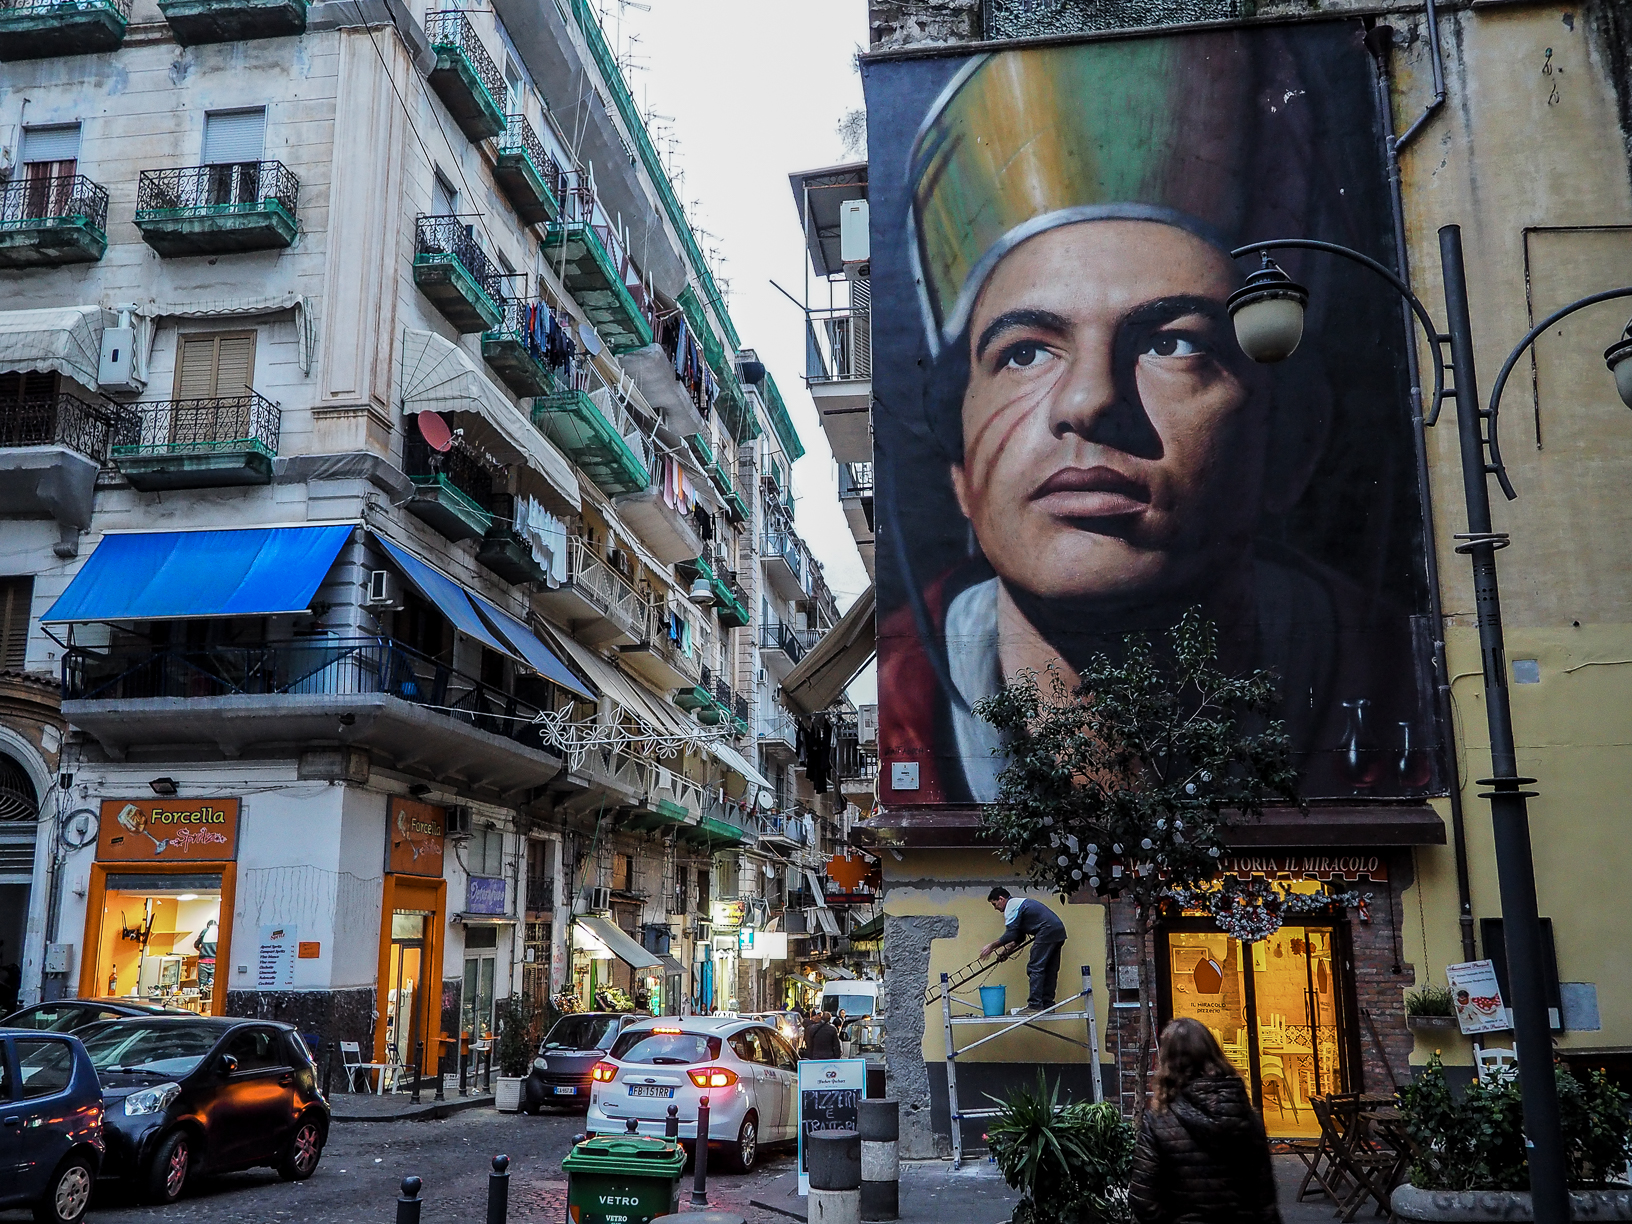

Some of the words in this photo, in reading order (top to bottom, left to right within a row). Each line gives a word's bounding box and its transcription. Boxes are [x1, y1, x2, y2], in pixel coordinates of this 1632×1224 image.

[151, 807, 225, 824] Forcella
[411, 817, 442, 837] Forcella
[1284, 857, 1299, 871] IL
[1301, 856, 1379, 871] MIRACOLO
[826, 1109, 834, 1118] E
[599, 1195, 639, 1206] VETRO
